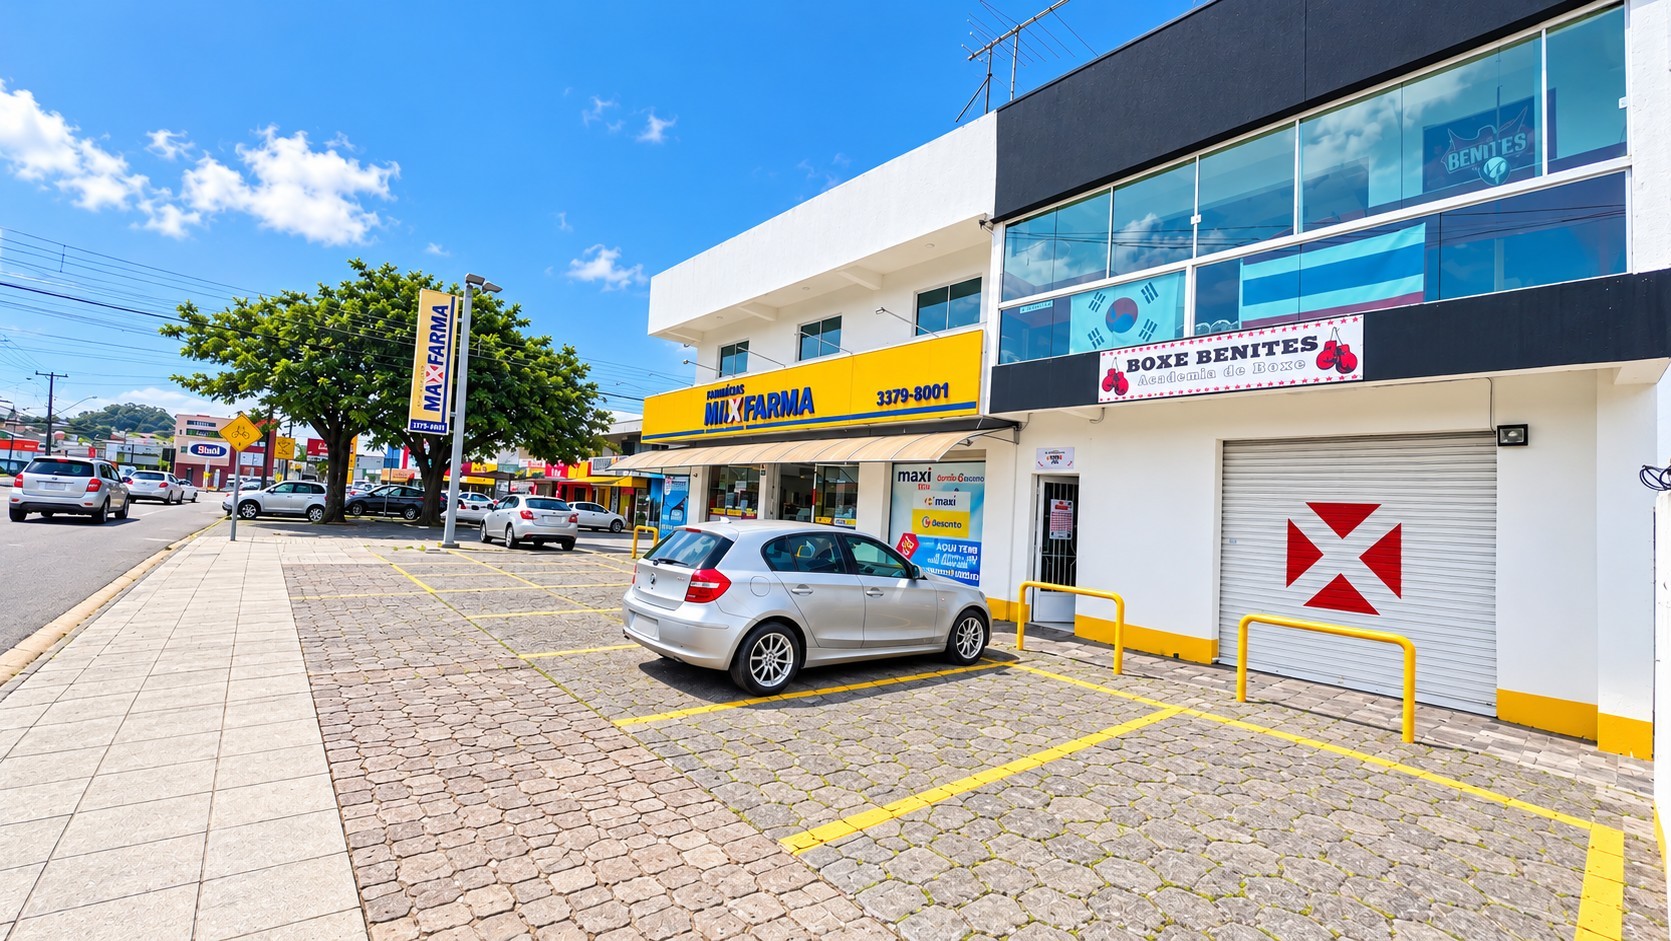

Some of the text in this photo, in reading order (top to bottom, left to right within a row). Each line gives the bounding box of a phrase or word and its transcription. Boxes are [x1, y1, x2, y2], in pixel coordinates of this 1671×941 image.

[1448, 131, 1527, 172] BENITES
[1126, 335, 1319, 373] BOXE BENITES
[1137, 359, 1306, 387] Academia de Boxe
[876, 382, 949, 406] 3379-8001
[897, 467, 932, 482] maxi
[935, 495, 956, 506] maxi
